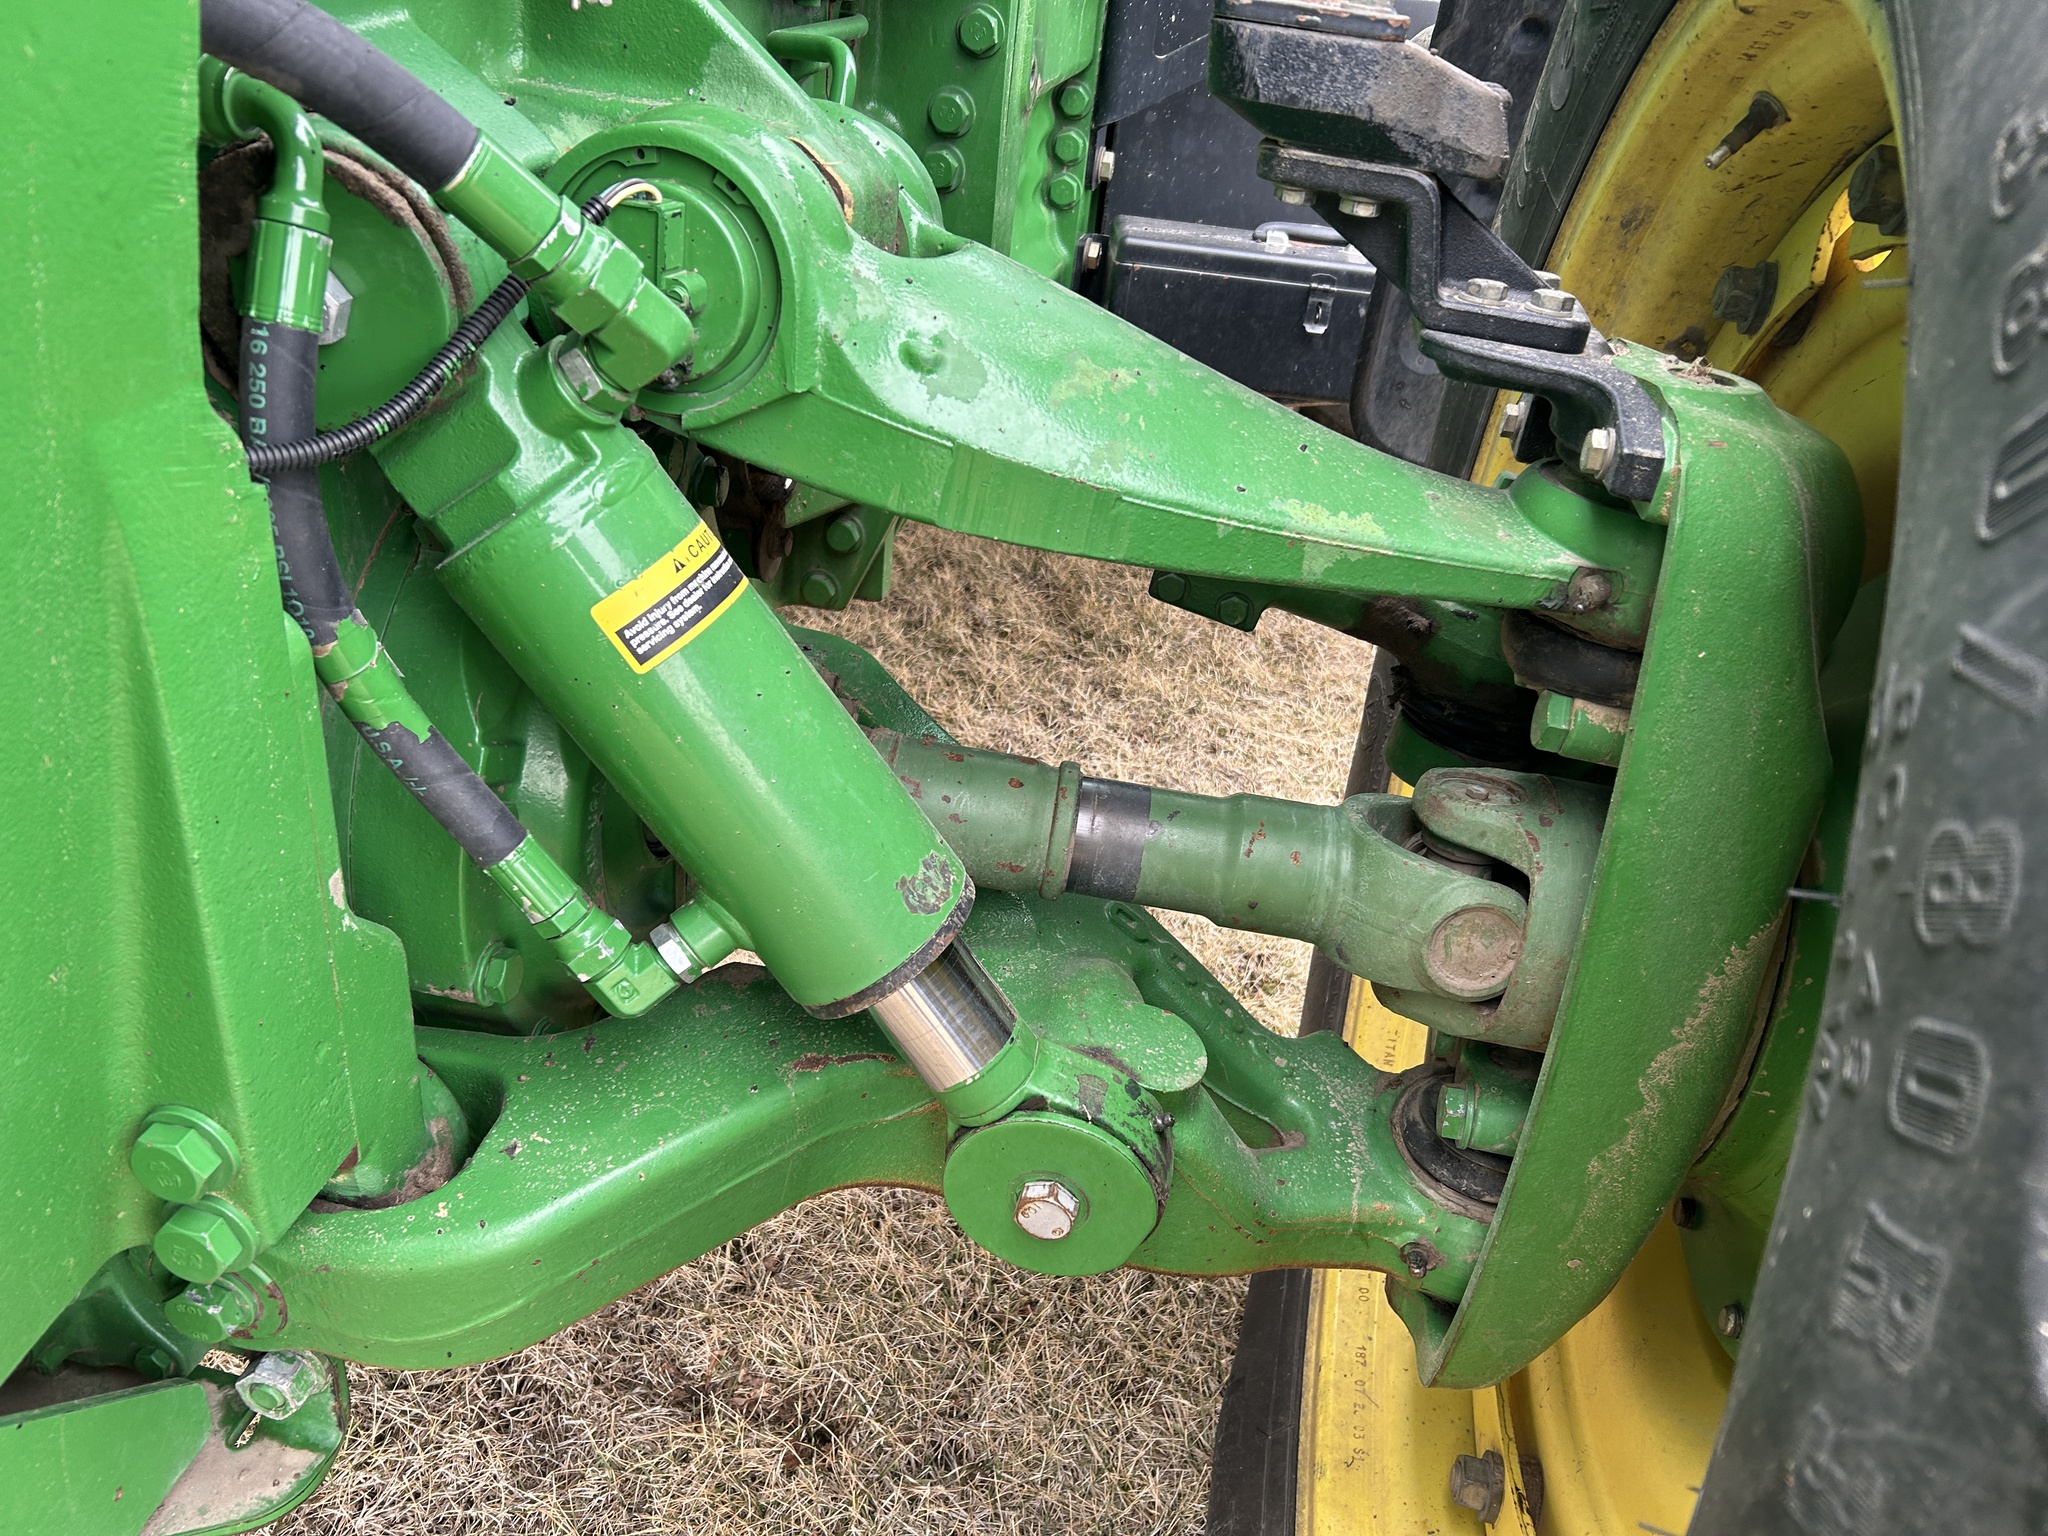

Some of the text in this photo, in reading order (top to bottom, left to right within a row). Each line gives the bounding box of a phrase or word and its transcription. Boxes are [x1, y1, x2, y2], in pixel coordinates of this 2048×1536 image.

[248, 325, 270, 447] 16 250 BA
[624, 617, 649, 639] Avoid
[670, 587, 690, 605] from
[629, 618, 669, 649] pressure.
[667, 604, 685, 620] See
[682, 587, 705, 608] dealer
[702, 578, 713, 592] for
[636, 603, 703, 655] servicing system.
